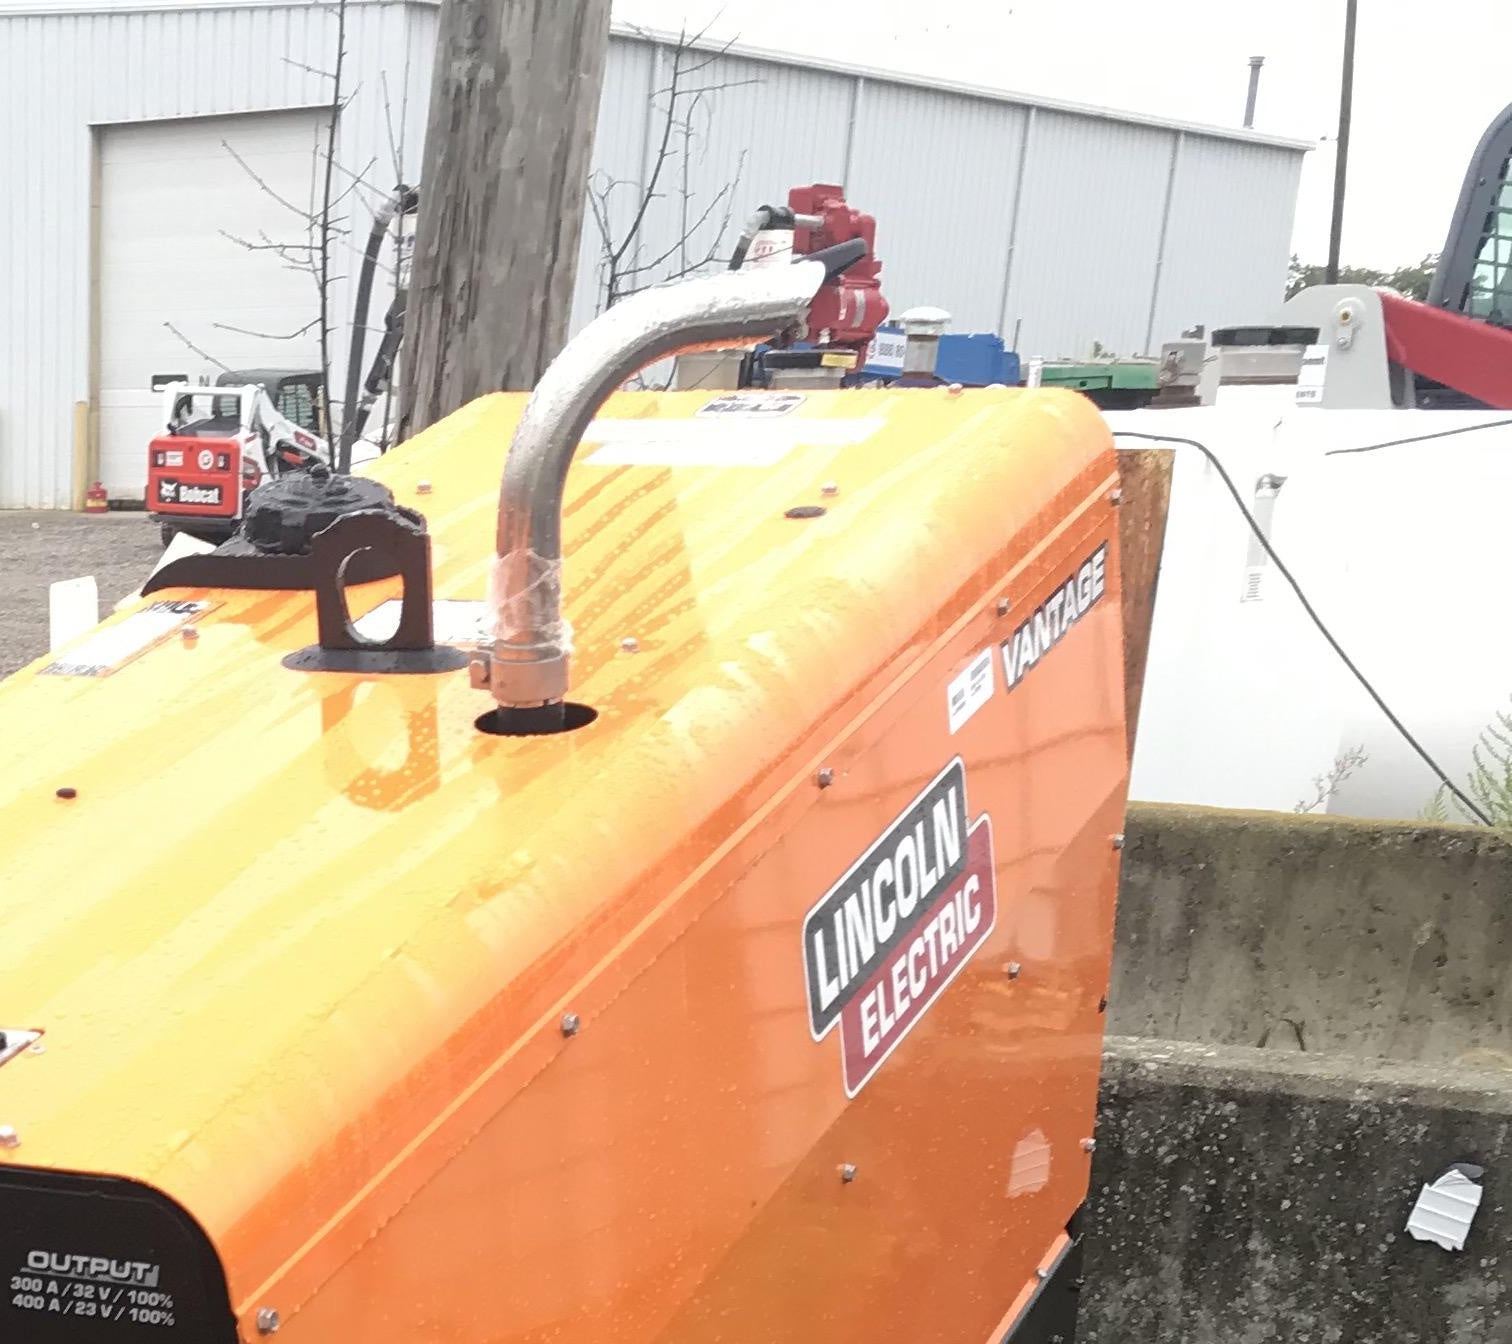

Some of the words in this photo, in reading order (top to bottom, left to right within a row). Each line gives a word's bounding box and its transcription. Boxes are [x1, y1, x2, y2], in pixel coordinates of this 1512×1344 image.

[179, 486, 219, 503] Bobcat
[1002, 544, 1108, 690] VANTAGE
[814, 786, 962, 1013] LINCOLN
[862, 874, 981, 1058] ELECTRIC
[27, 1250, 151, 1281] OUTPUT
[10, 1276, 43, 1293] 300
[127, 1290, 174, 1309] 100%
[12, 1293, 45, 1310] 400
[129, 1307, 176, 1326] 100%
